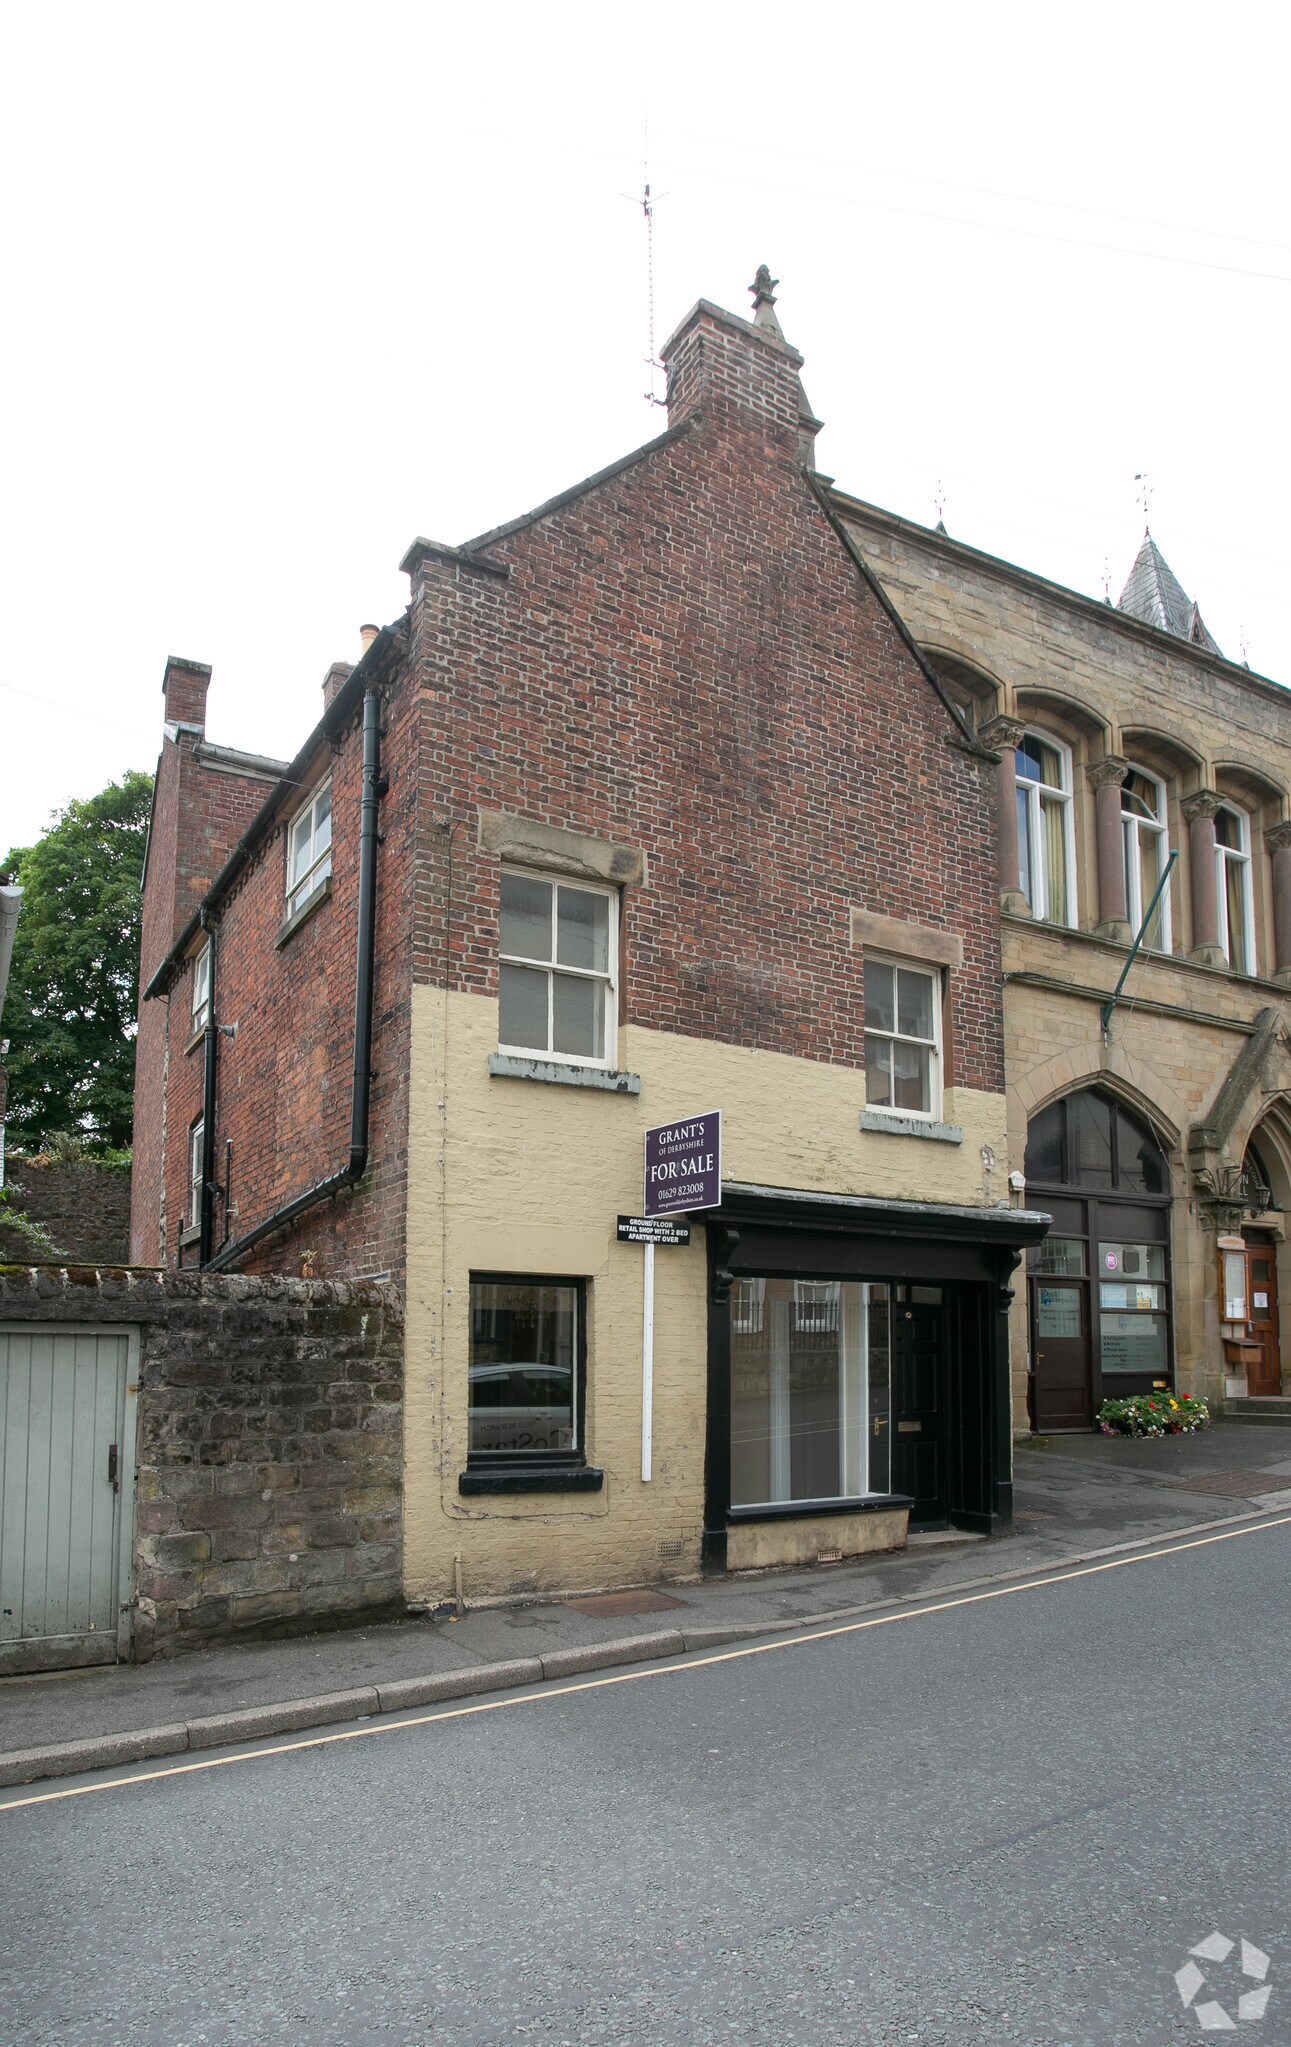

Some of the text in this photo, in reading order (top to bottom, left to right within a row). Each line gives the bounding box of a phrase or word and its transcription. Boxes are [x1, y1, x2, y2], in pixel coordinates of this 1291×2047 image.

[659, 1122, 705, 1145] GRANT'S
[658, 1138, 705, 1156] OF DERBYSHIRE
[650, 1153, 714, 1183] FOR SALE
[658, 1182, 704, 1200] 01629 823008
[618, 1224, 638, 1233] RETAIL
[638, 1226, 654, 1234] SHOP
[629, 1218, 653, 1227] GROUND
[628, 1232, 662, 1242] APARTMENT
